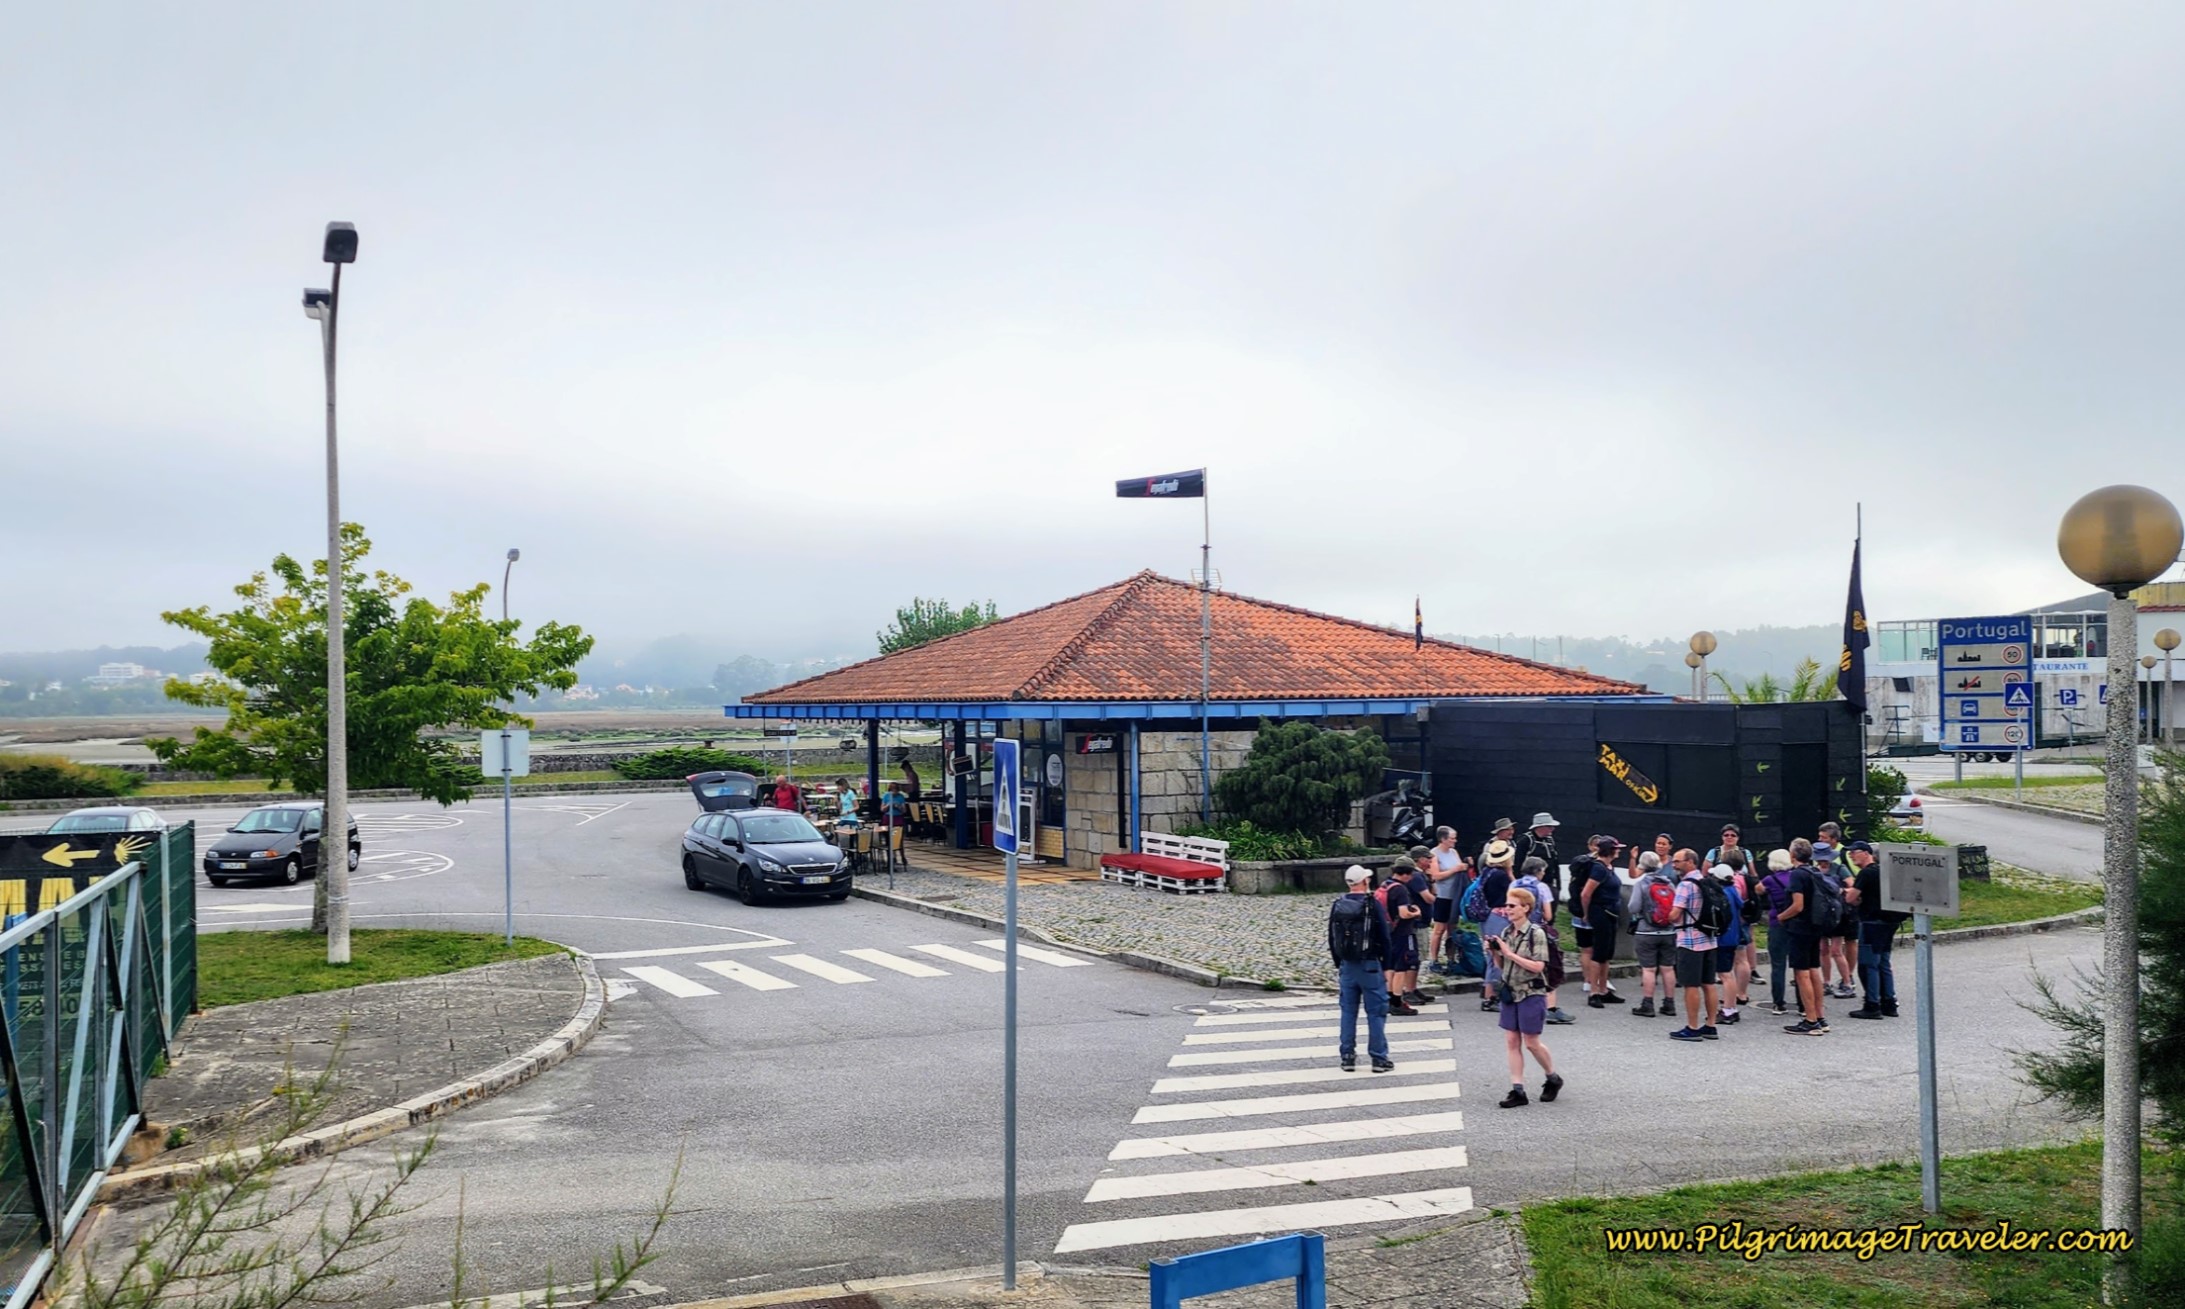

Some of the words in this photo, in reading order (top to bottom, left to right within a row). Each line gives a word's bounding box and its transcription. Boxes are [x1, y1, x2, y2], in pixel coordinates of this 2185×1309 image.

[1942, 621, 2027, 640] Portugal
[2063, 691, 2073, 703] P
[1892, 856, 1944, 868] PORTUGAL
